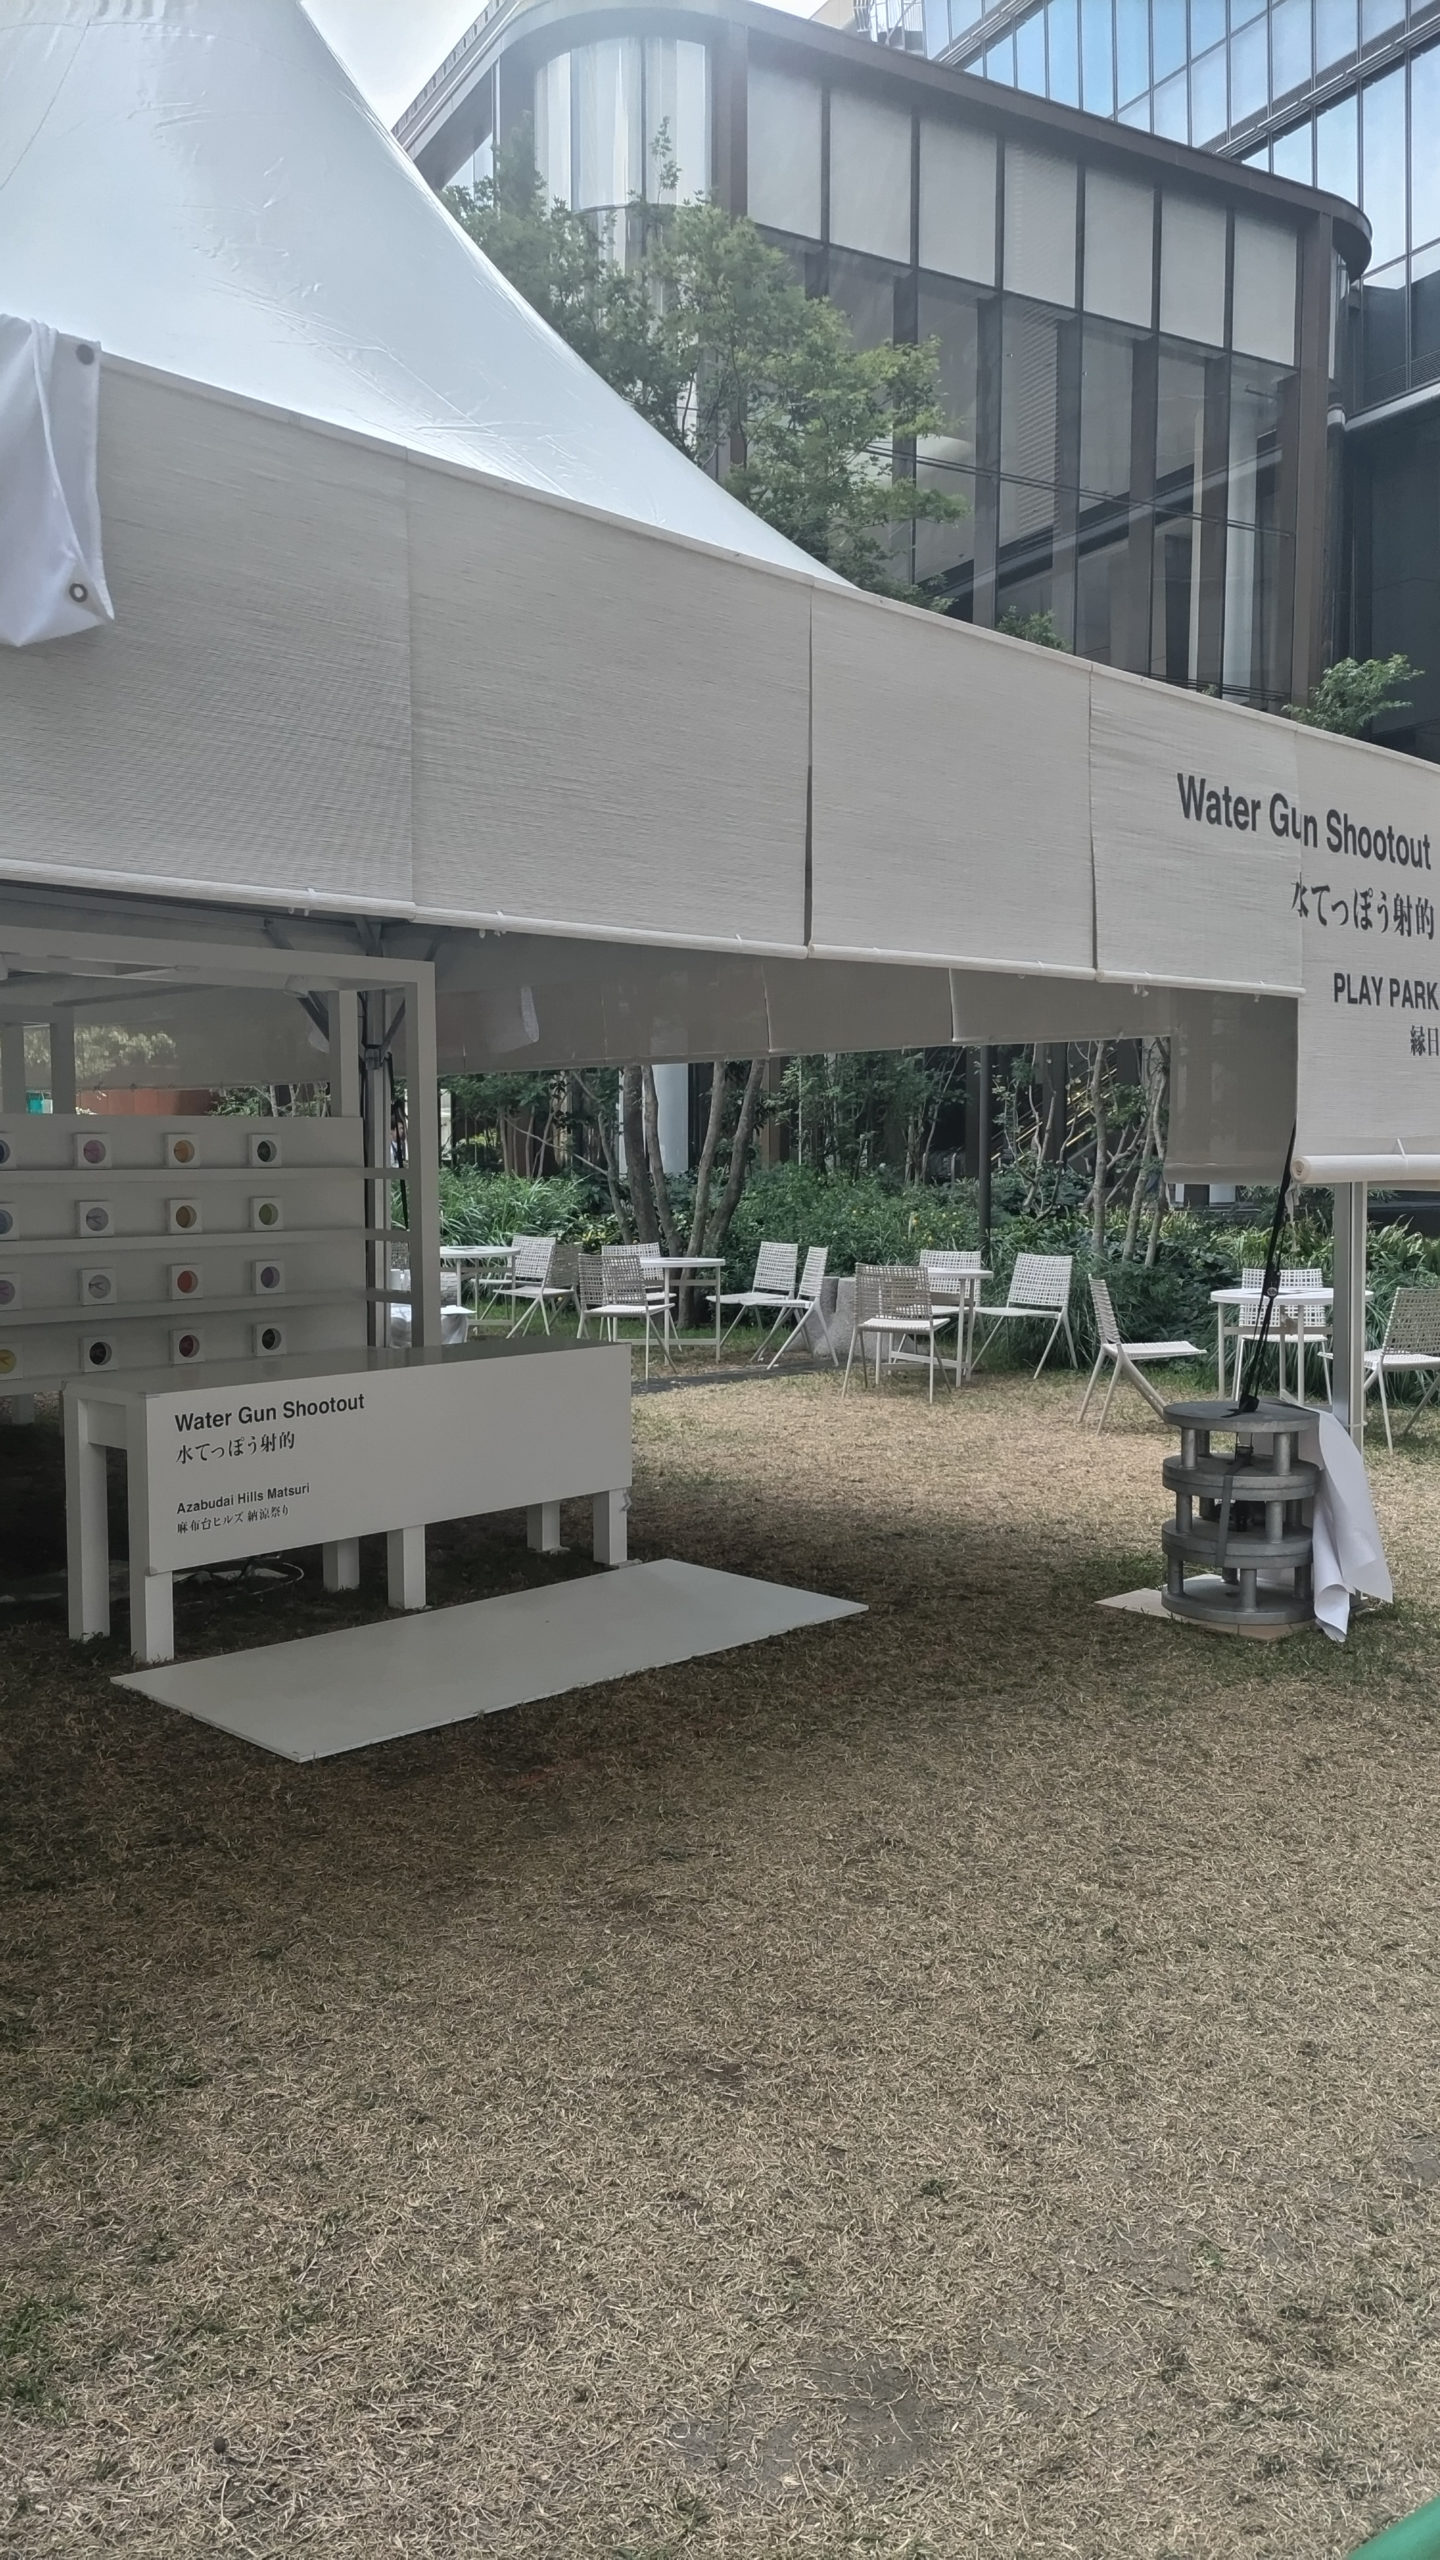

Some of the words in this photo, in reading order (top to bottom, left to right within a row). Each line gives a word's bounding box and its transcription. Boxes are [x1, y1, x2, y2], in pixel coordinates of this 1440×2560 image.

[1177, 772, 1261, 832] Water
[1269, 792, 1318, 848] Gun
[1326, 809, 1432, 871] Shootout
[1290, 872, 1434, 940] 水てっぽう射的
[1333, 972, 1384, 1006] PLAY
[1389, 977, 1440, 1010] PARK
[174, 1411, 232, 1432] Water
[238, 1405, 277, 1424] Gun
[283, 1393, 365, 1418] Shootout
[176, 1431, 295, 1464] 水てっぽう射的
[176, 1494, 234, 1514] Azabudai
[237, 1490, 264, 1505] Hills
[267, 1482, 310, 1500] Matsuri
[176, 1511, 244, 1534] 麻布台ヒルズ
[247, 1504, 289, 1522] 納涼祭り
